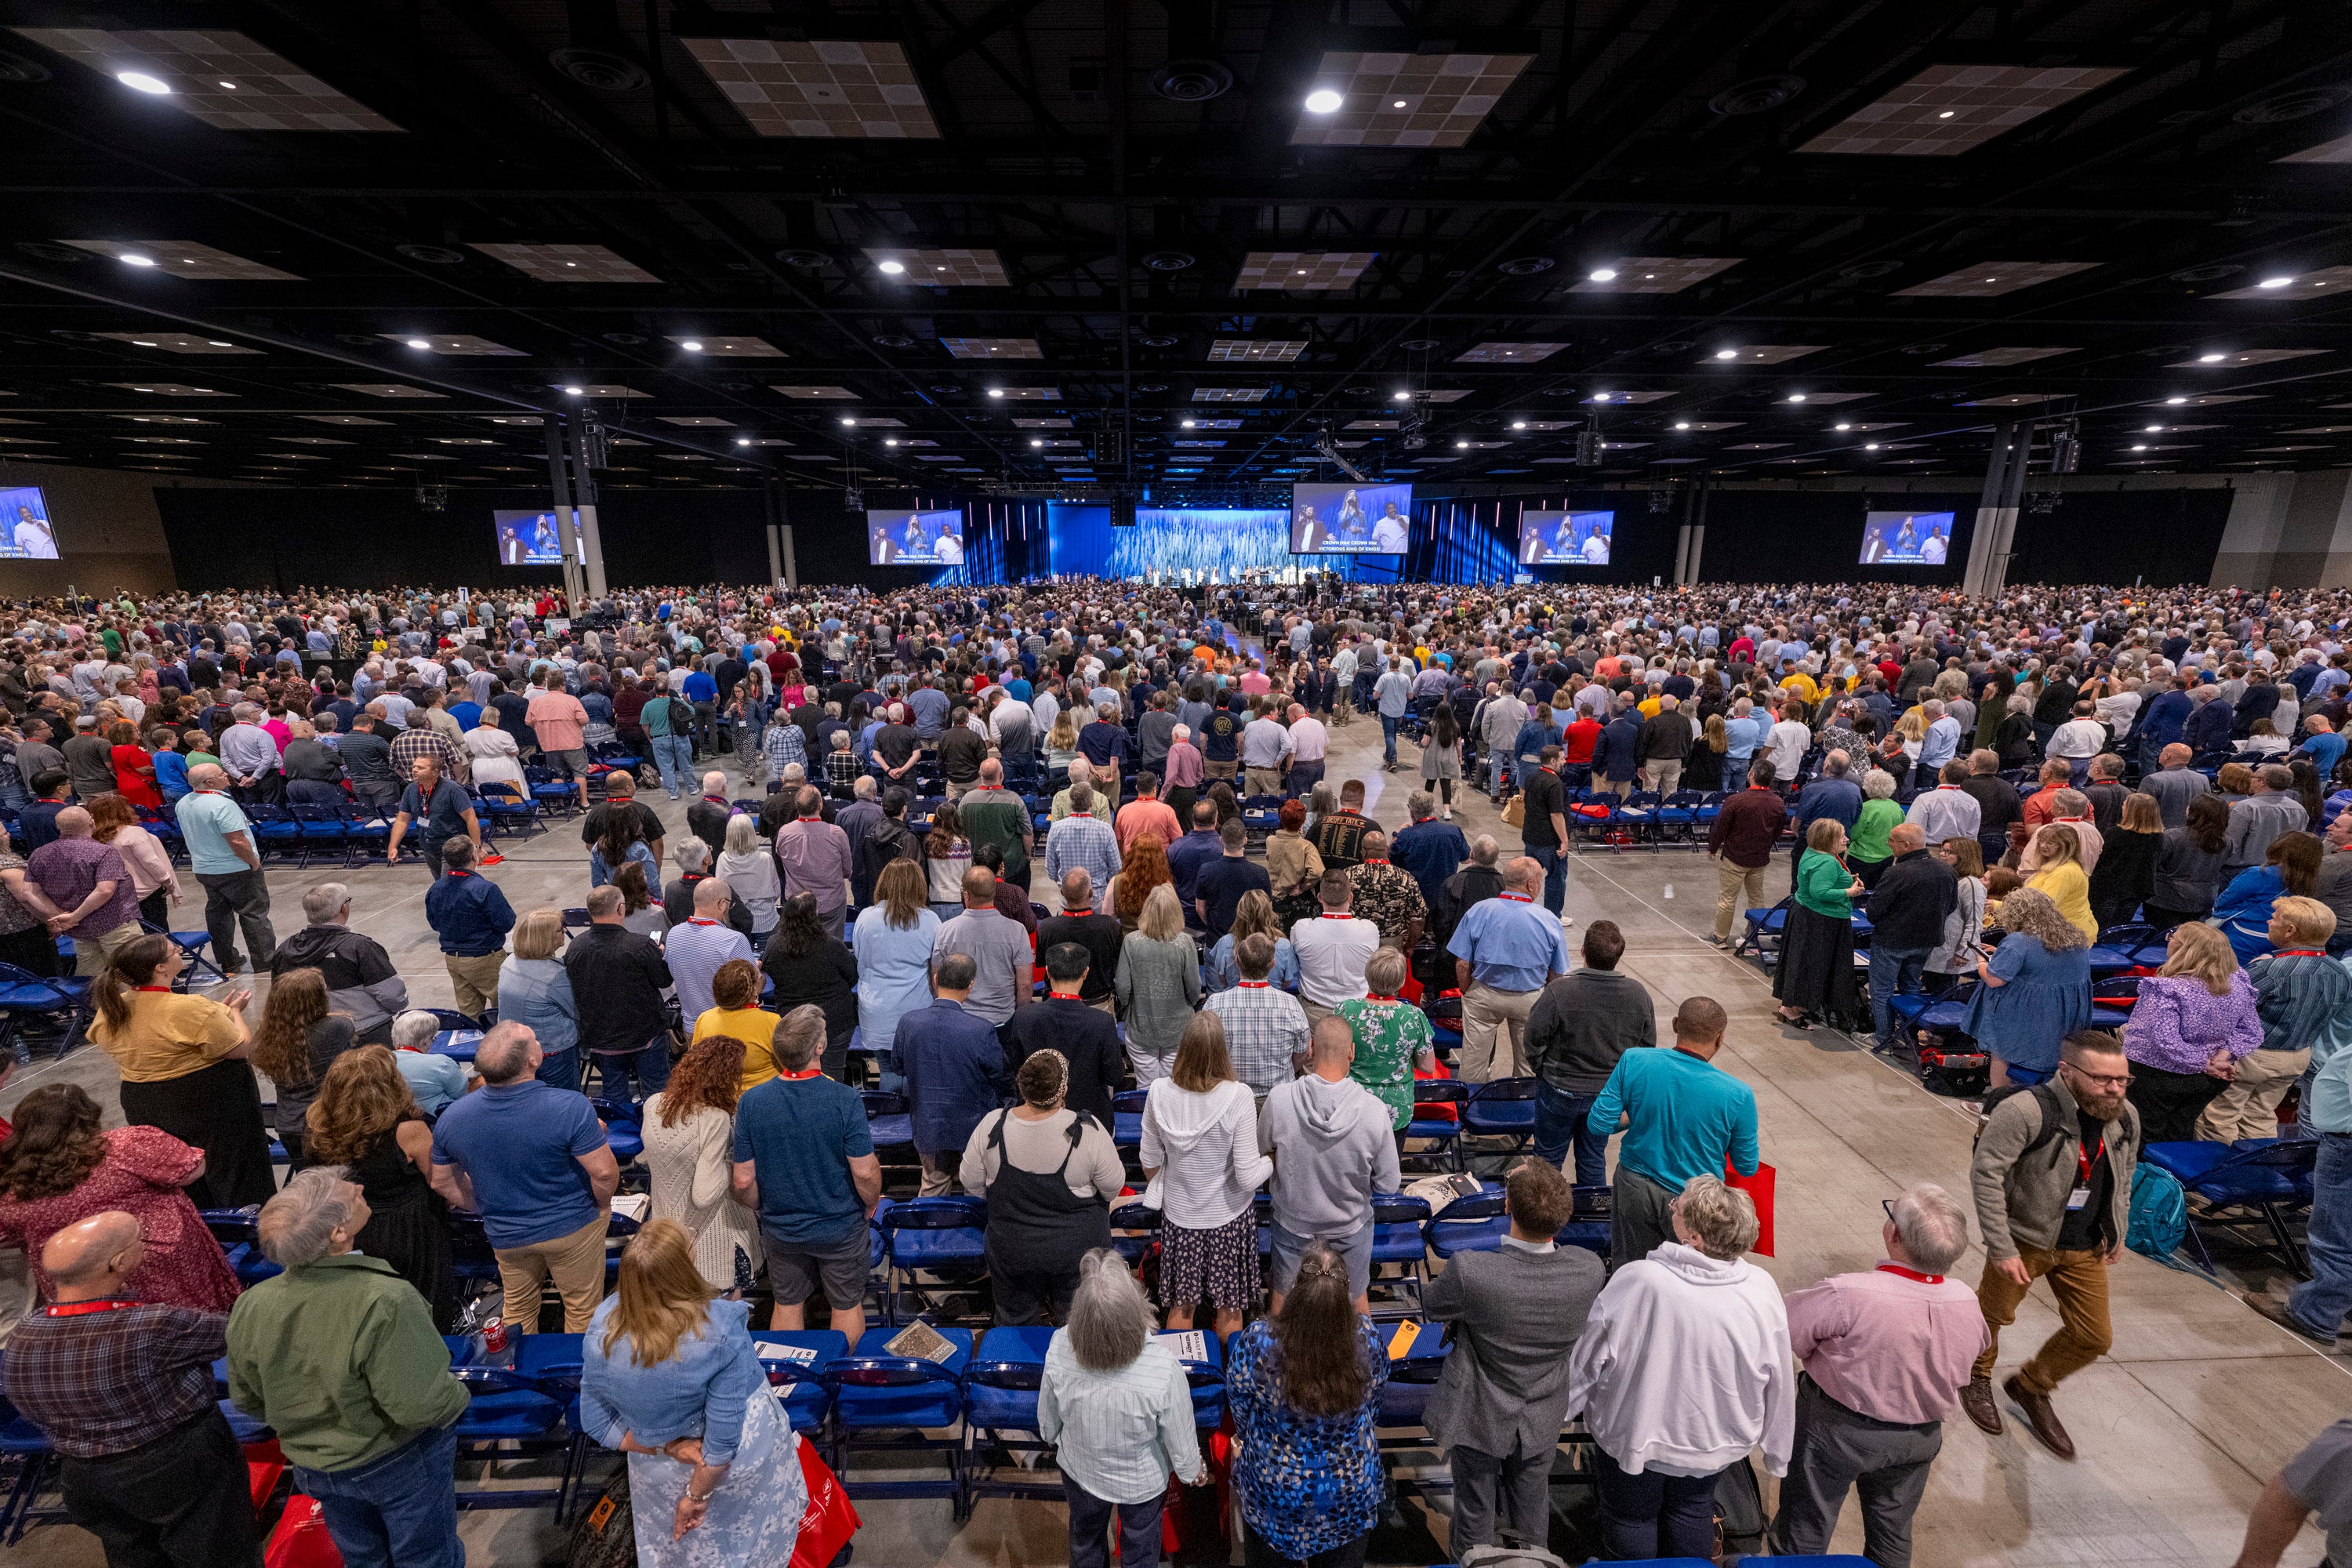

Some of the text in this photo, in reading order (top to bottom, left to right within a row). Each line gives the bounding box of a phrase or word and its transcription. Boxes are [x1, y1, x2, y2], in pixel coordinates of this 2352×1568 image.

[460, 588, 466, 602] 7
[1497, 583, 1503, 595] 10
[931, 1344, 950, 1361] ATION
